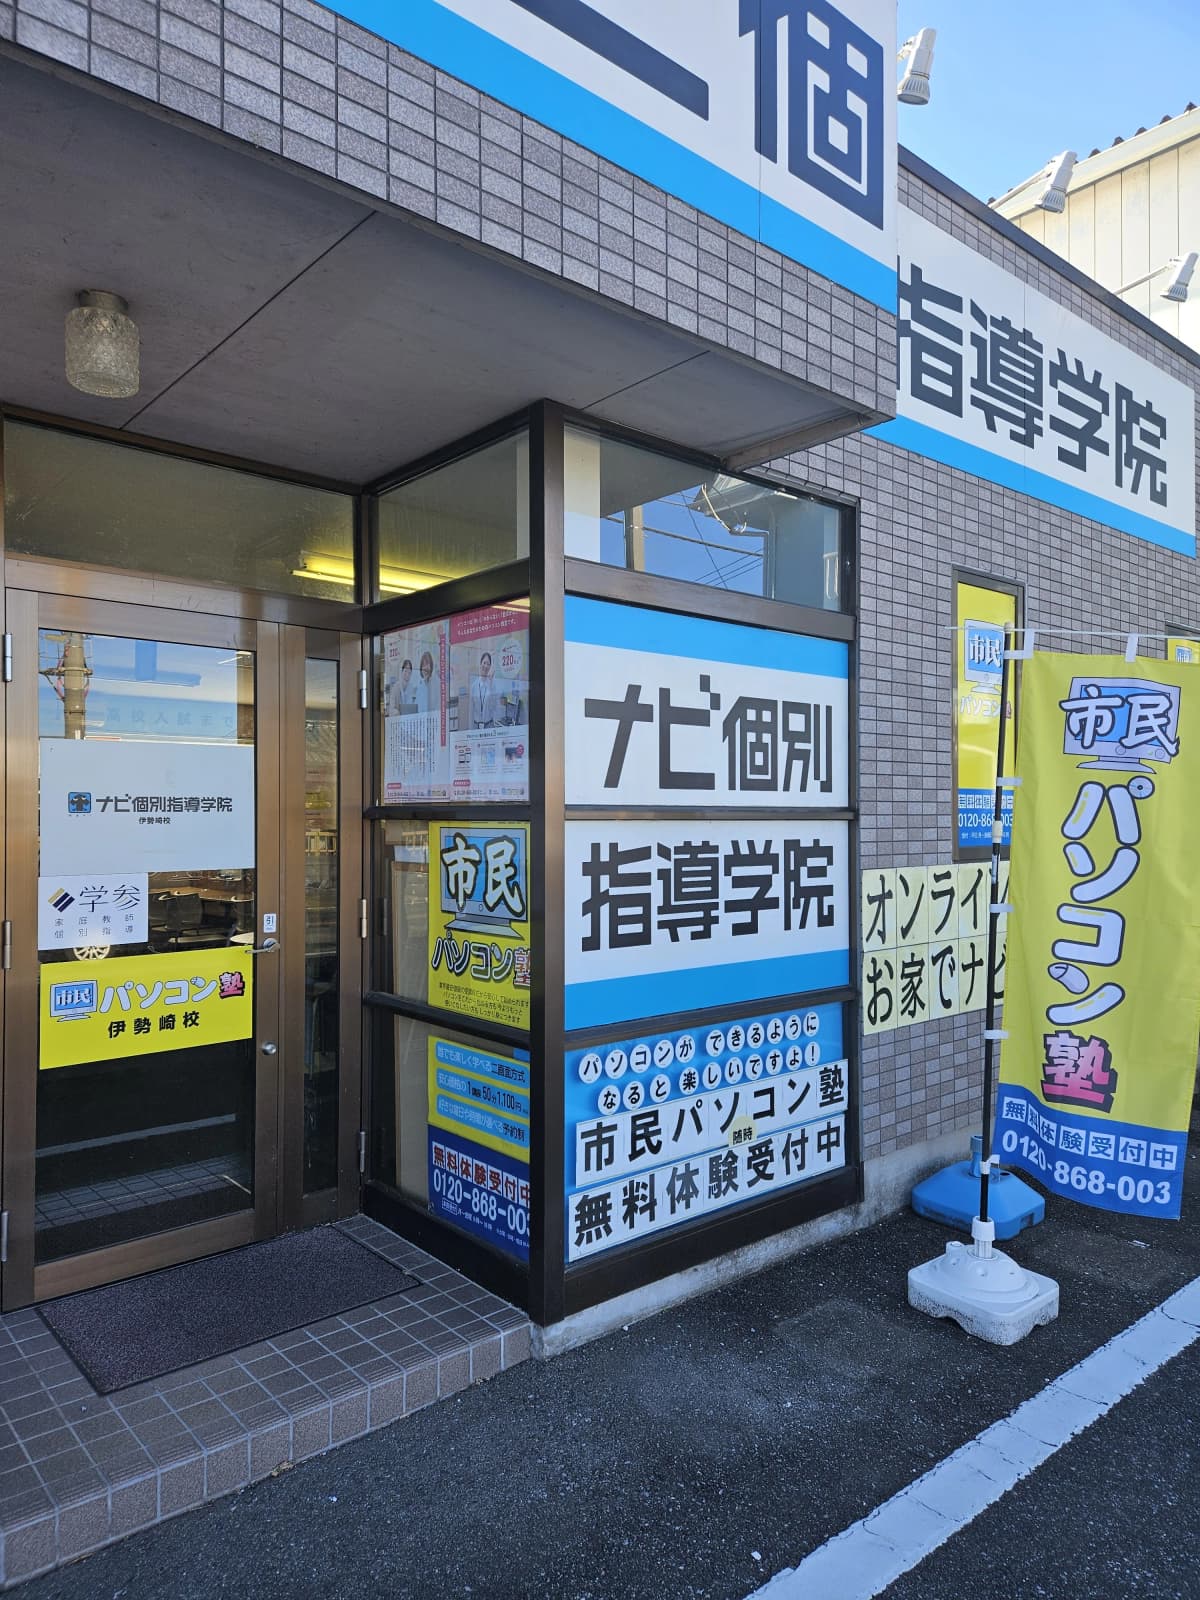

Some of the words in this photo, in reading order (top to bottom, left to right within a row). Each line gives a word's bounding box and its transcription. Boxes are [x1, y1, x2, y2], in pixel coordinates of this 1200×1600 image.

[898, 254, 1167, 507] 指導学院
[968, 633, 1002, 669] 市民
[584, 674, 833, 793] ナビ個別
[1058, 684, 1181, 757] 市民
[96, 793, 232, 813] ナビ個別指導学院
[138, 816, 171, 825] 伊勢崎校
[79, 884, 141, 913] 学参
[441, 832, 526, 916] 市民
[581, 839, 834, 952] 指導学院
[54, 913, 134, 927] 家庭教師
[54, 925, 134, 939] 個別指導
[1040, 776, 1155, 1114] パソコン塾
[57, 989, 93, 1006] 市民
[108, 1010, 200, 1039] 伊勢崎校
[580, 1064, 845, 1173] 市民パソコン塾
[732, 1127, 753, 1144] 随時
[1004, 1100, 1174, 1168] 無料体験受付中
[433, 1145, 530, 1208] 無料体験受付中
[574, 1121, 841, 1248] 無料体験受付中
[1002, 1130, 1171, 1204] 0120-868-003
[433, 1168, 530, 1237] 0120-868-00
